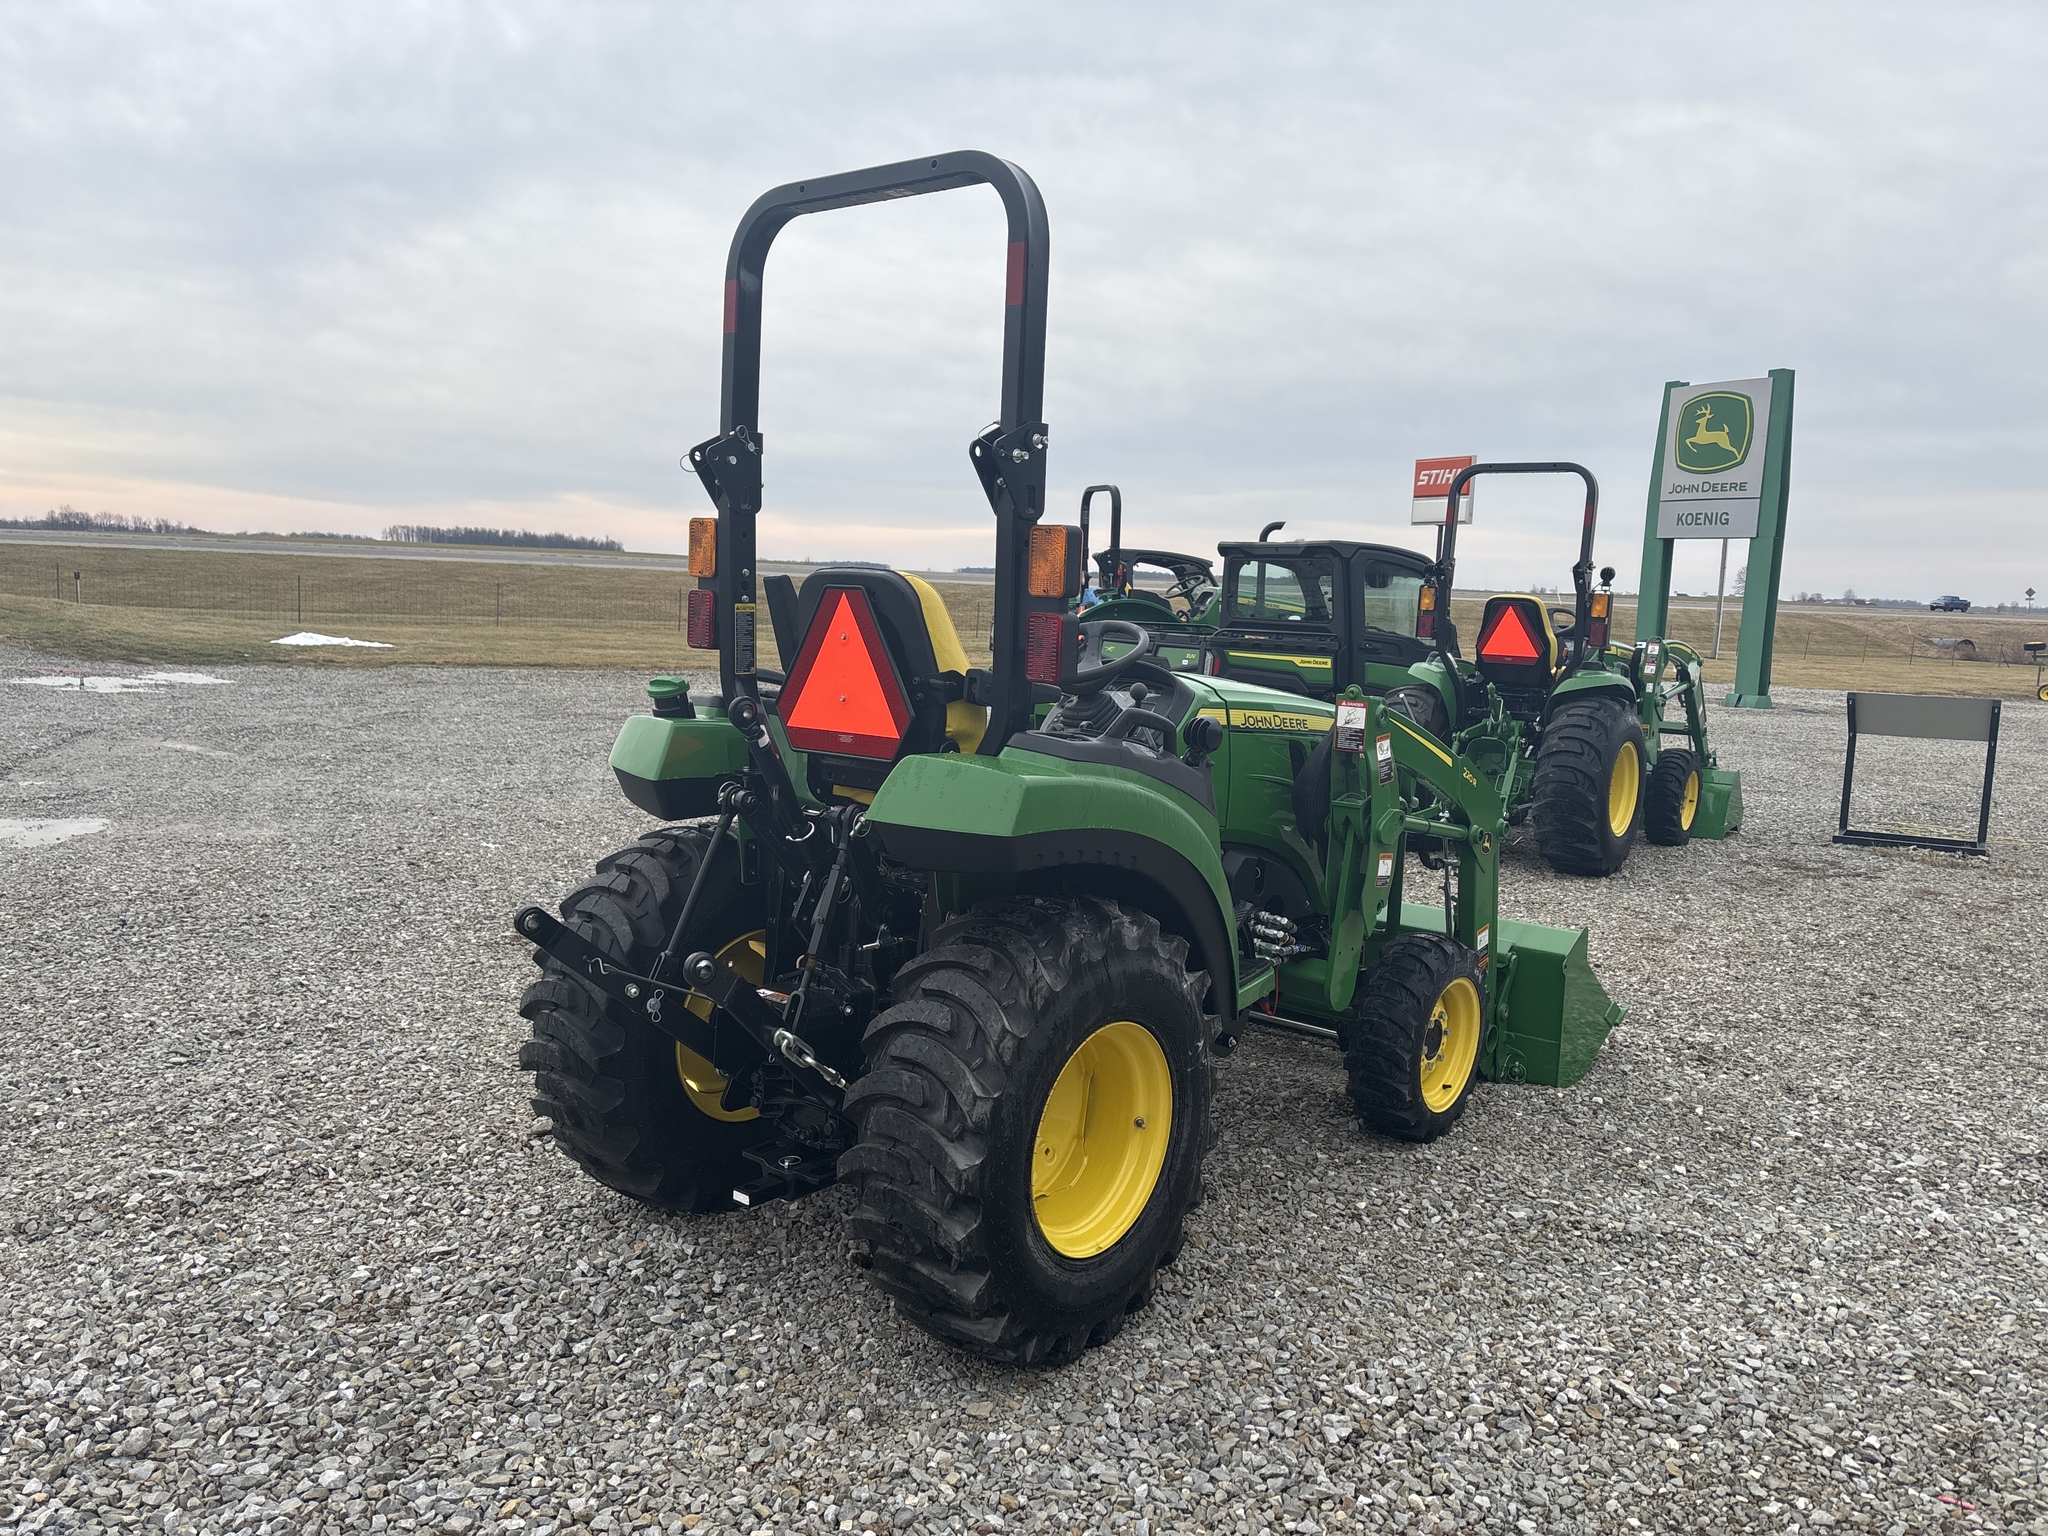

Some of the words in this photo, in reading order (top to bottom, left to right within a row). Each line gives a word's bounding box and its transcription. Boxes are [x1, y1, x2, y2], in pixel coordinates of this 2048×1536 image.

[1668, 483, 1700, 494] JOHN
[1701, 481, 1748, 493] DEERE
[1676, 512, 1730, 526] KOENIG
[1241, 713, 1272, 727] JOHN
[1273, 715, 1309, 729] DEERE
